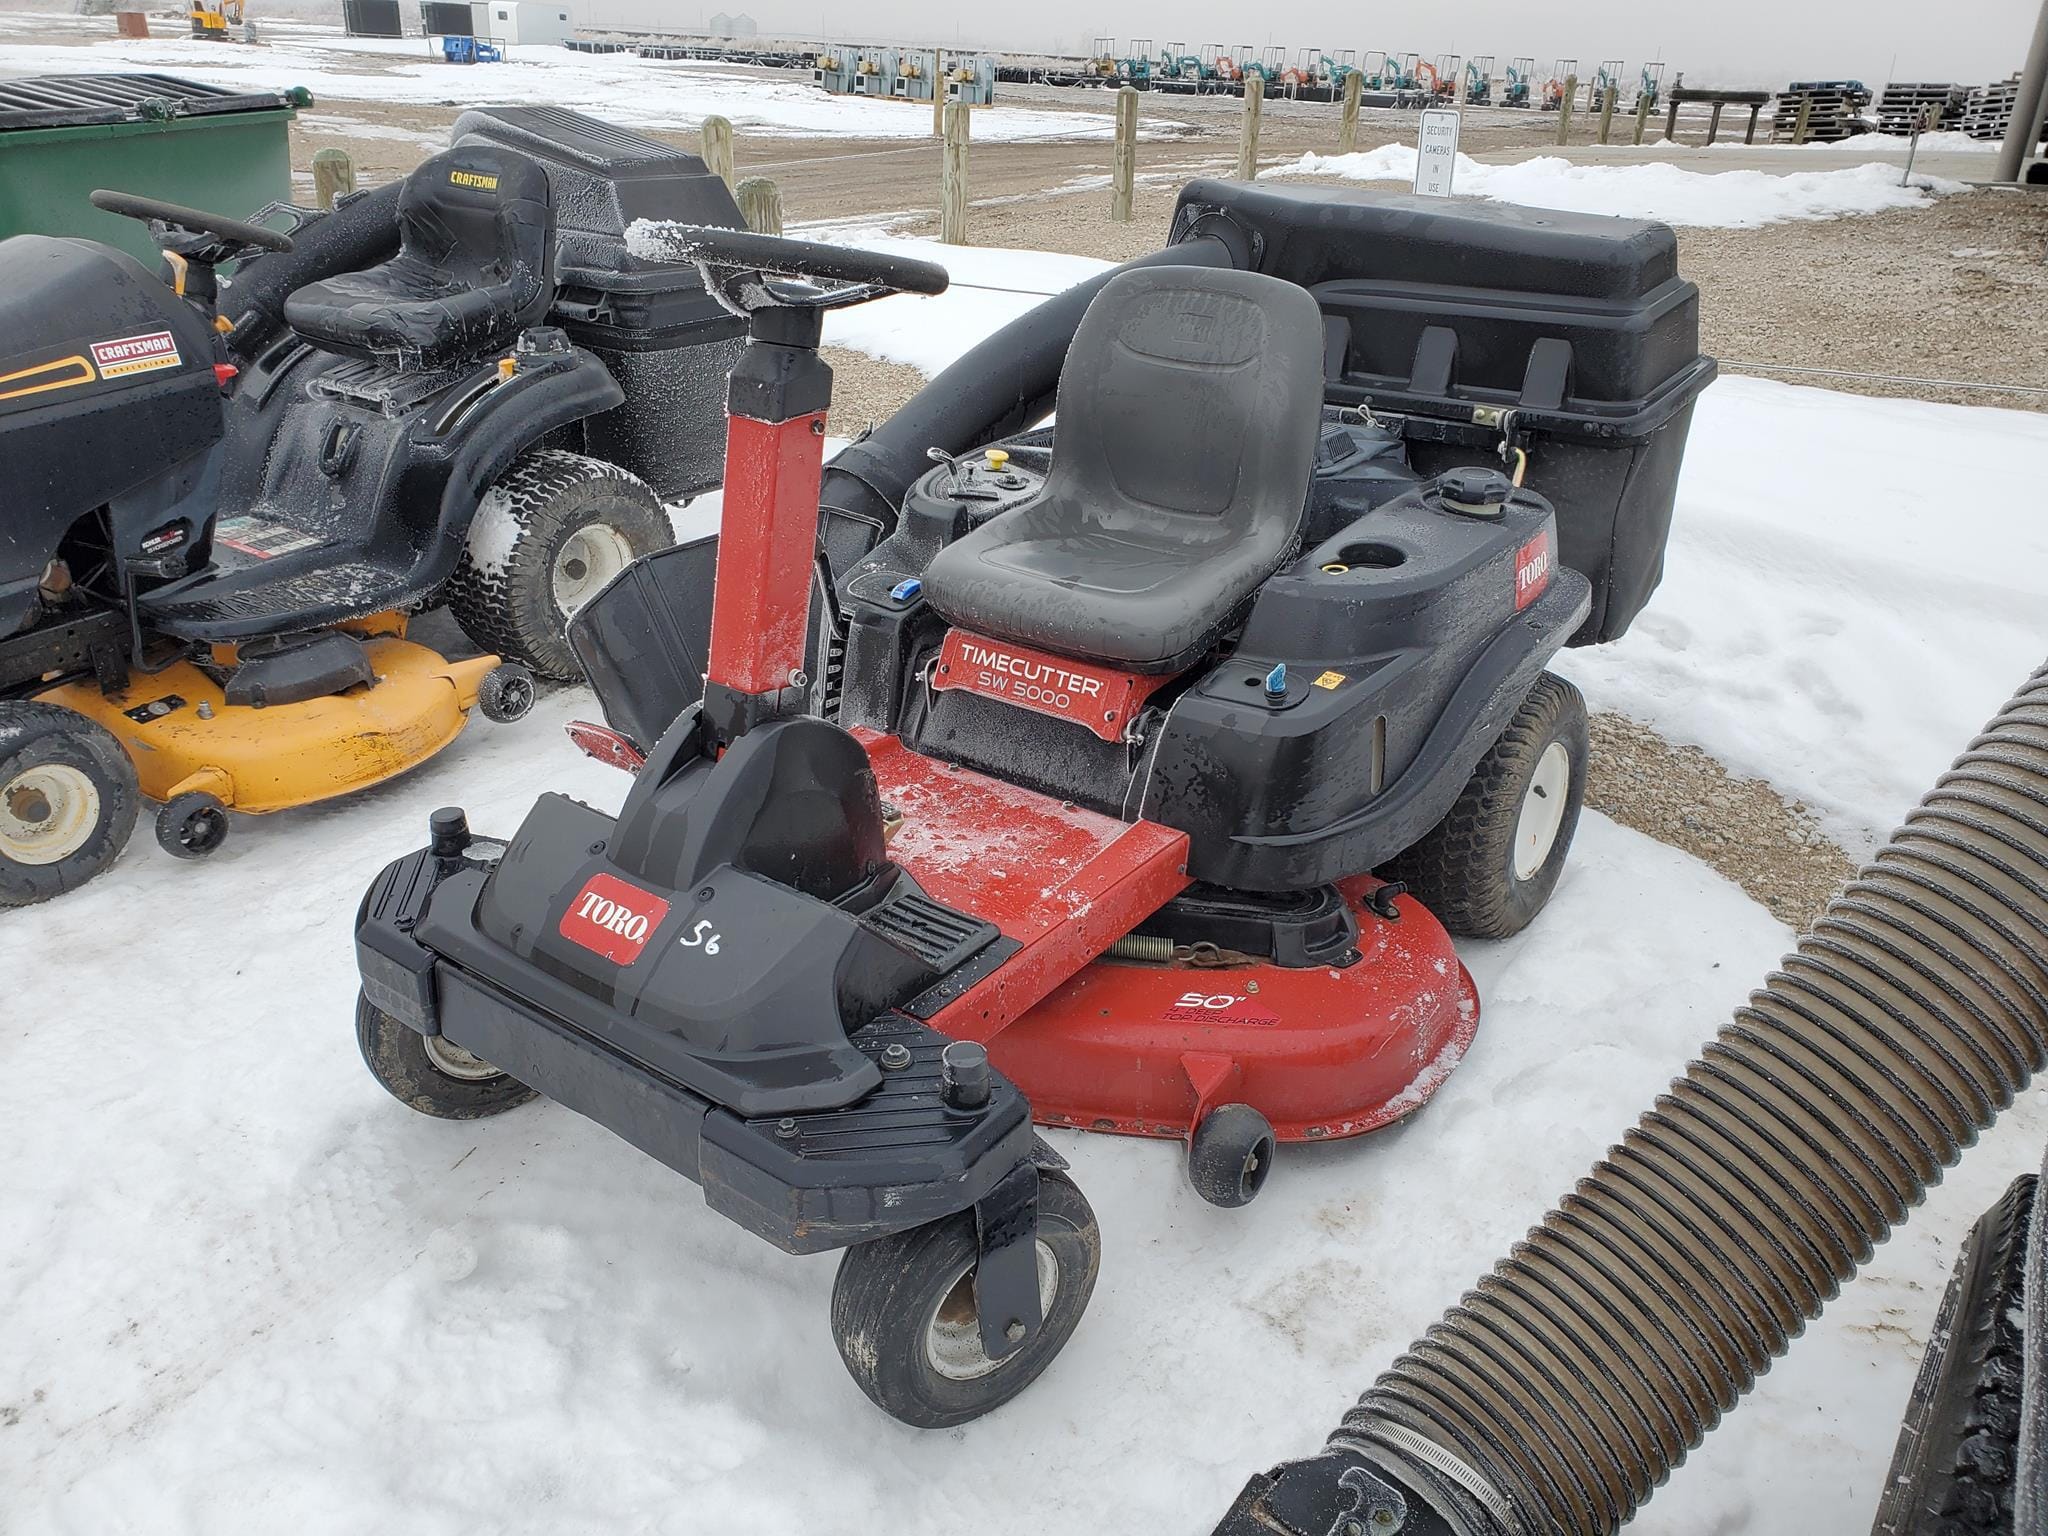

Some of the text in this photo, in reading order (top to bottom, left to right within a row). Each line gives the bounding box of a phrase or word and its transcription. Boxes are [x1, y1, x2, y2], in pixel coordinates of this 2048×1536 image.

[1426, 125, 1453, 136] SECURITY
[1425, 144, 1451, 156] CAMERAS
[1432, 164, 1440, 174] IN
[450, 171, 498, 190] CRAFTSMAN
[1428, 183, 1440, 193] USE
[97, 337, 171, 361] CRAFTSMAN
[1518, 551, 1547, 591] TORO
[961, 643, 1104, 698] TIMECUTTER
[978, 671, 1070, 709] SW 5000
[577, 891, 649, 944] TORO
[679, 919, 721, 955] 56
[1162, 1013, 1280, 1026] TOP DISCHARGE
